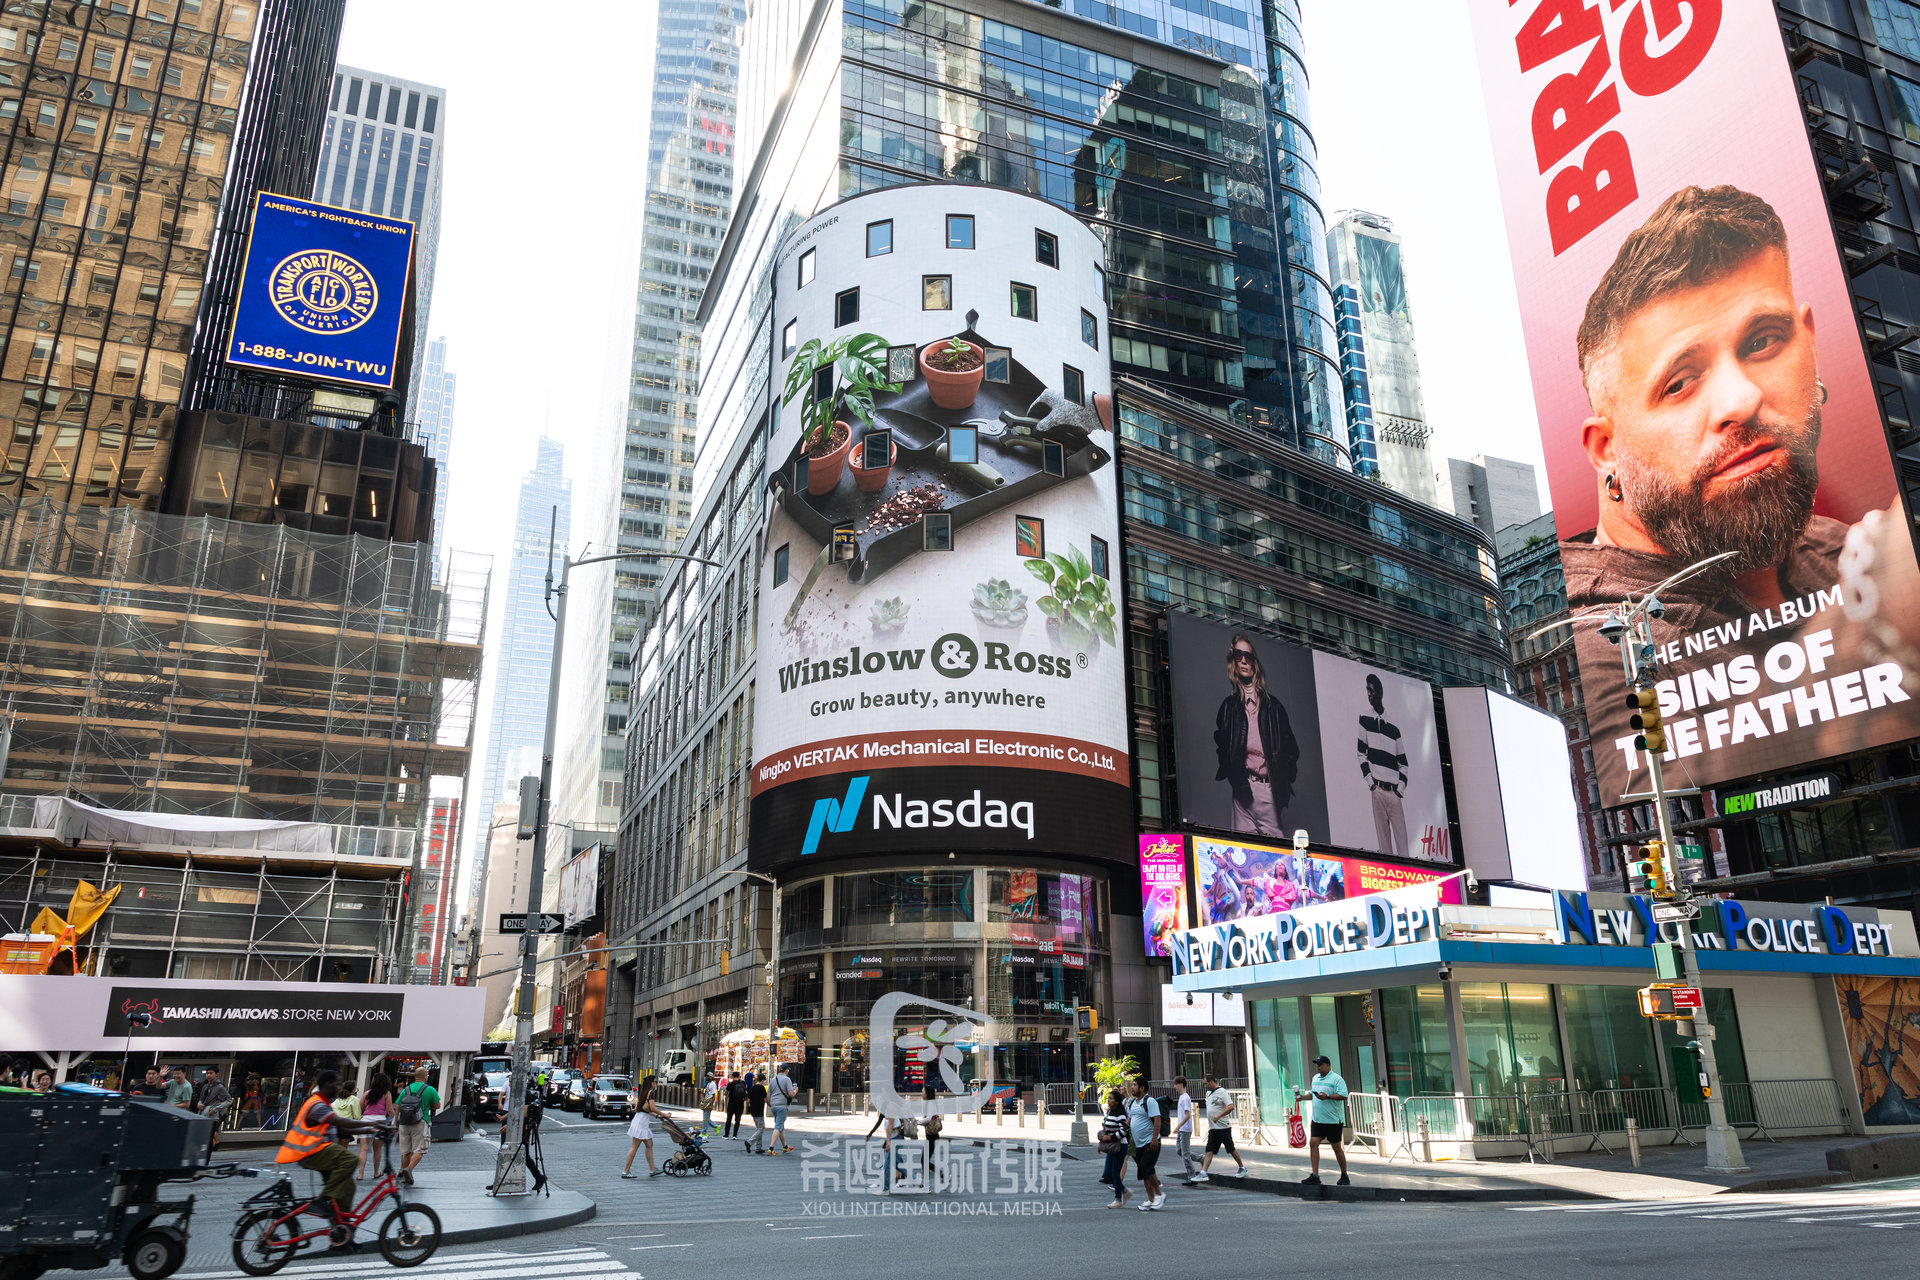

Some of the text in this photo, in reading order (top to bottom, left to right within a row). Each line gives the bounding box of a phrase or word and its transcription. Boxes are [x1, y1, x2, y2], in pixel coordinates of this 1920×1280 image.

[1508, 0, 1639, 258] BRA
[264, 201, 407, 235] AMERICA'S FIGHTBACK UNION
[812, 215, 839, 236] POWER
[277, 255, 371, 313] TRANSPORT WORKERS
[310, 276, 322, 304] AFL
[328, 279, 340, 307] CIO
[284, 304, 358, 329] OF AMERICA
[302, 309, 338, 322] UNION
[238, 341, 387, 376] 1-888-JOIN-TWU
[1653, 584, 1845, 667] HE NEW ALBUM
[778, 647, 925, 694] Winslow
[1653, 628, 1836, 718] SINS OF
[810, 689, 1046, 717] Grow beauty, anywhere
[1704, 662, 1912, 750] FATHER
[759, 738, 1116, 782] Ningbo VERTAK Mechanical Electronic Co.,Ltd.
[873, 790, 1035, 840] Nasdaq
[427, 807, 447, 867] PARK
[1420, 824, 1449, 860] H&M
[1146, 873, 1181, 881] THE BOX OFFICE
[1166, 864, 1177, 873] FEES
[1177, 864, 1183, 873] AT
[1361, 876, 1404, 891] BIGGEST
[506, 919, 552, 928] ONE AY
[1553, 889, 1632, 944] NEW
[1718, 900, 1821, 953] POLICE
[1820, 906, 1893, 956] DEPT
[1677, 905, 1693, 914] WAY
[1171, 896, 1438, 975] NEW YORK POLICE DEPT
[860, 956, 882, 964] Nasdaq
[1012, 956, 1035, 964] Nasdaq
[162, 1007, 222, 1019] TAMASHII
[283, 1009, 323, 1021] STORE
[327, 1010, 355, 1020] NEW
[357, 1010, 392, 1021] YORK
